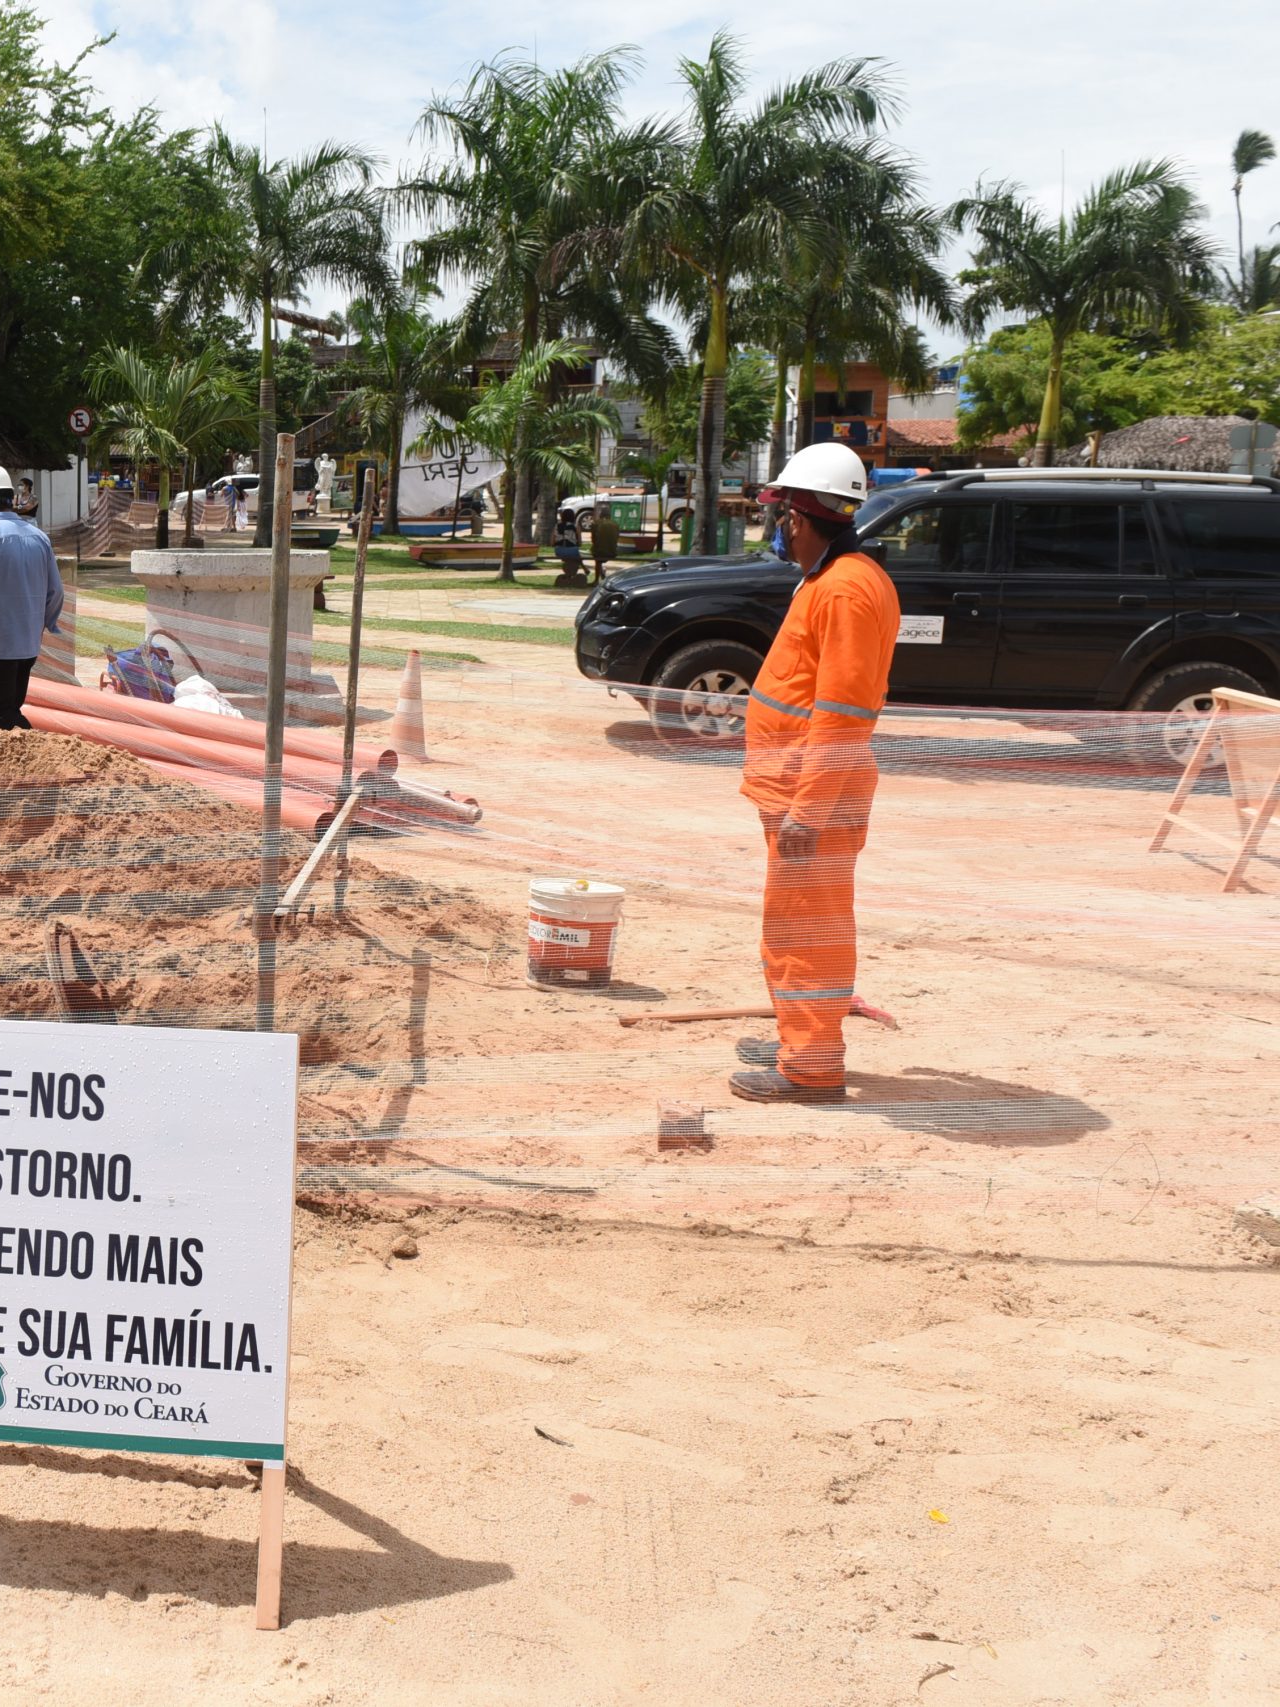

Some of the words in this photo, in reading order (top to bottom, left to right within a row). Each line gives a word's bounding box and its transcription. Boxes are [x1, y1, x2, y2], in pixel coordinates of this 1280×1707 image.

[107, 1234, 203, 1287] MAIS
[18, 1308, 92, 1361] SUA
[105, 1309, 272, 1374] FAMÍLIA.
[44, 1364, 152, 1393] GOVERNO
[15, 1387, 99, 1415] ESTADO
